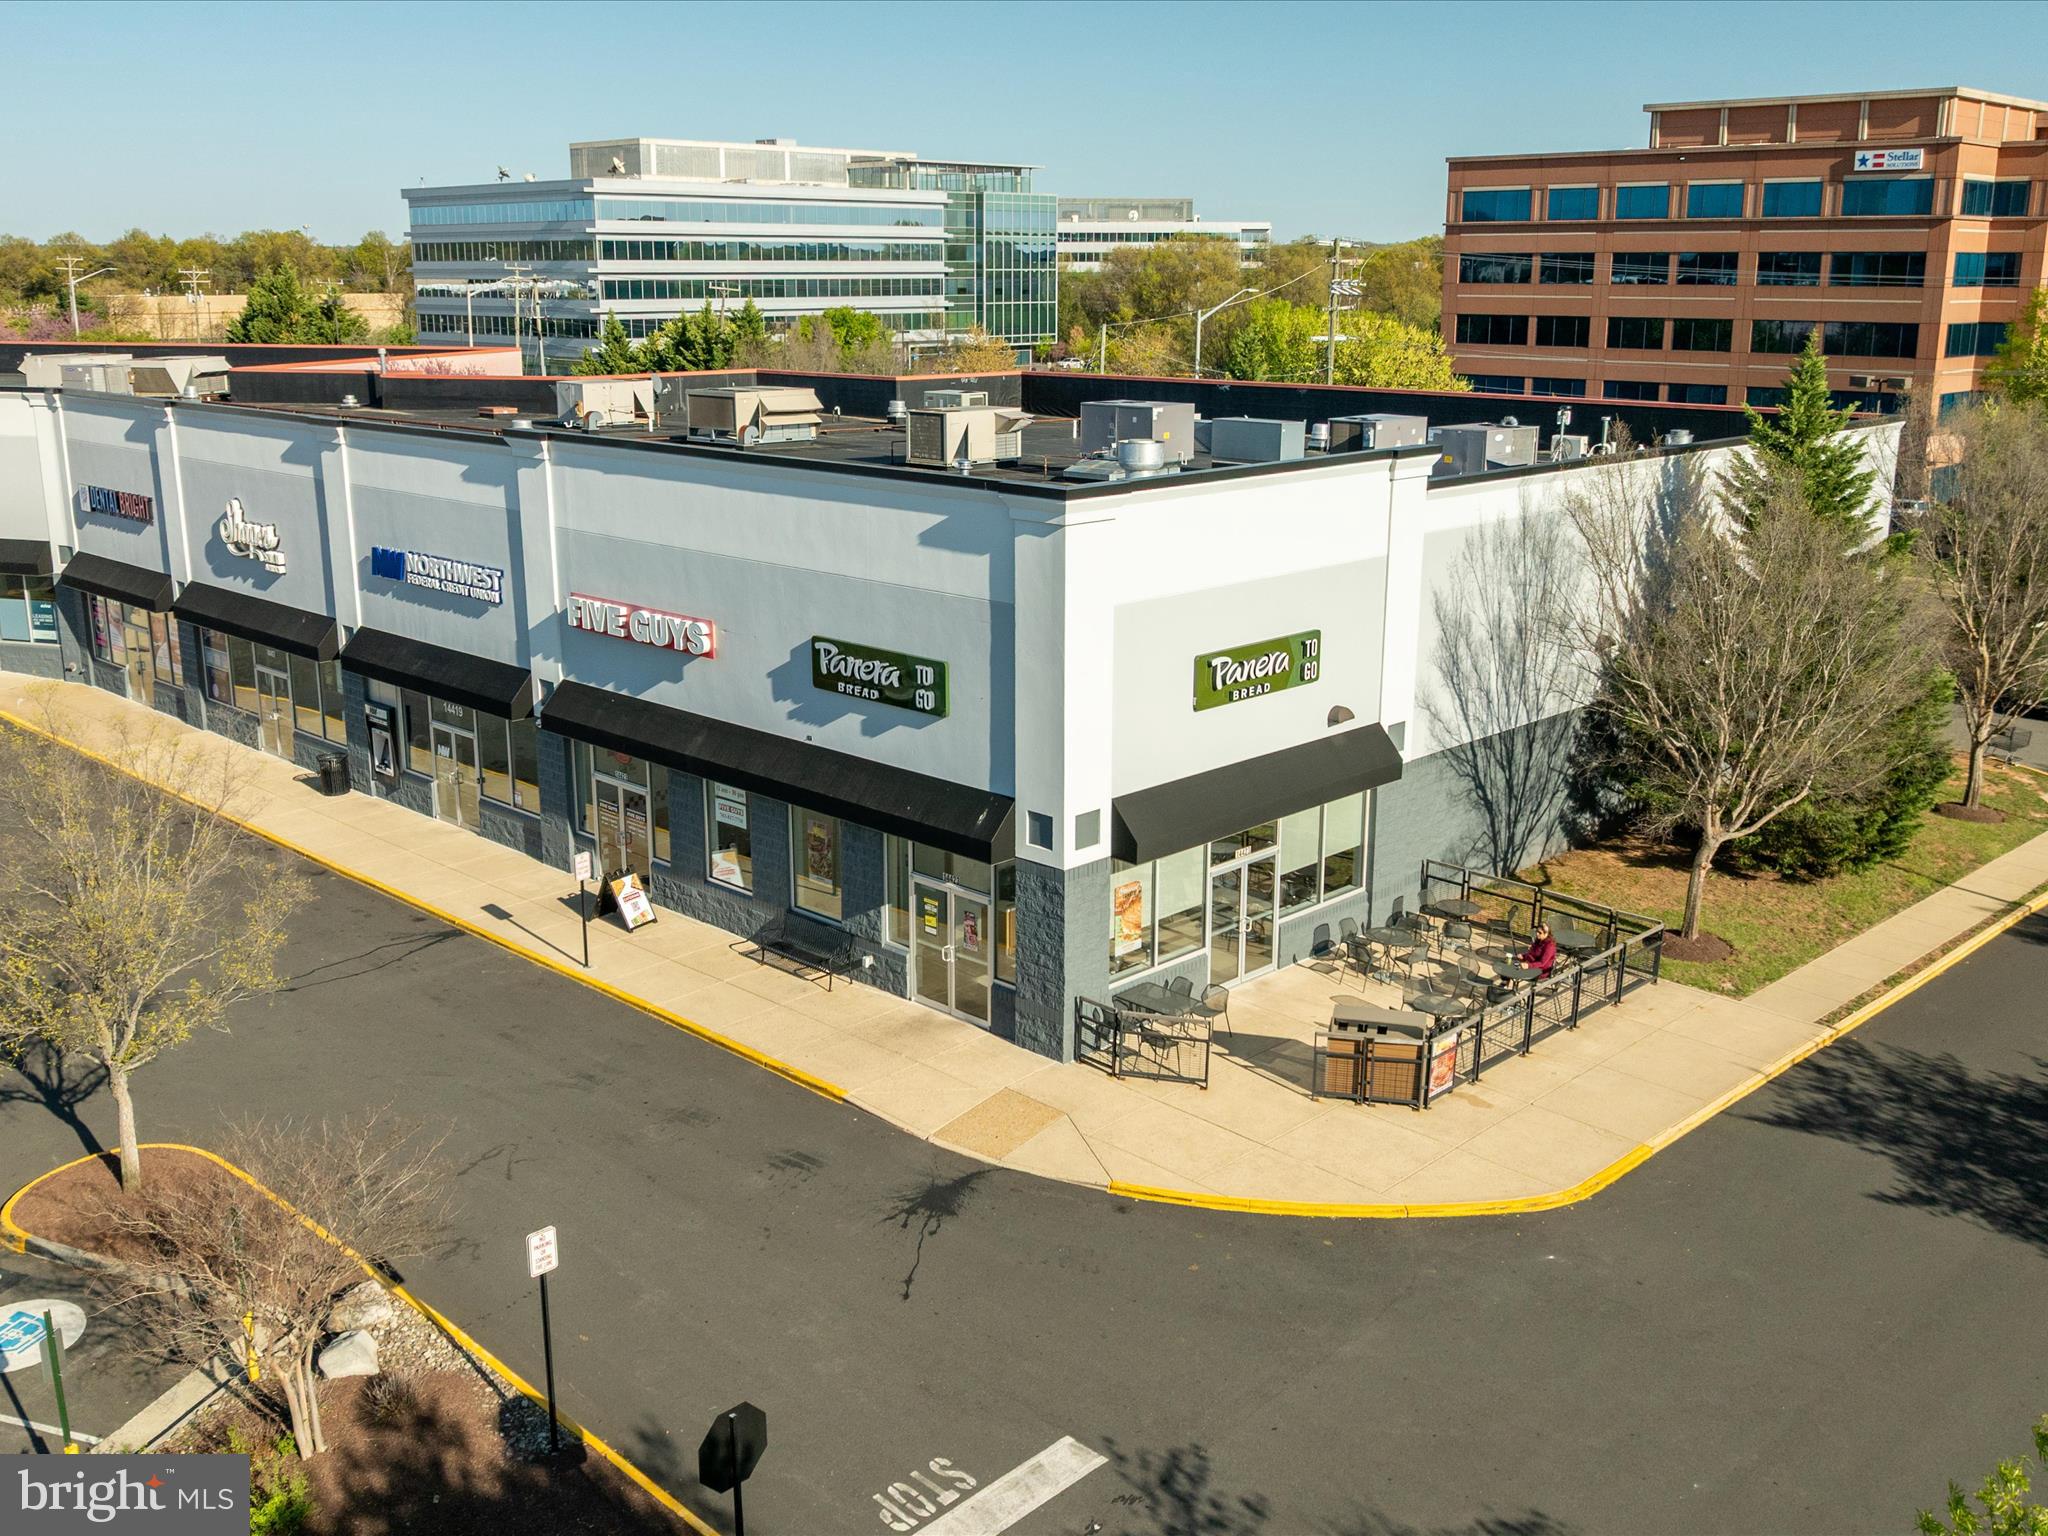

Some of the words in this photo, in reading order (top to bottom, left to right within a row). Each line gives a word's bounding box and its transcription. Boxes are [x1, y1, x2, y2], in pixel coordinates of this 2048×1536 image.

[1887, 151, 1919, 162] Stellar
[90, 486, 119, 513] DENTAL
[118, 491, 150, 520] BRIGHT
[406, 551, 503, 591] NORTHWEST
[406, 573, 441, 591] FEDERAL
[441, 579, 470, 597] CREDIT
[469, 585, 501, 604] UNION
[567, 596, 628, 638] FIVE
[629, 610, 712, 656] GUYS
[1304, 638, 1318, 658] TO
[815, 641, 901, 688] Panera
[915, 664, 934, 686] TO
[1209, 651, 1290, 691] Panera
[1303, 660, 1317, 681] GO
[837, 681, 880, 700] BREAD
[915, 688, 936, 710] GO
[1231, 682, 1271, 701] BREAD
[442, 702, 464, 718] 14419
[872, 1457, 977, 1532] STOP
